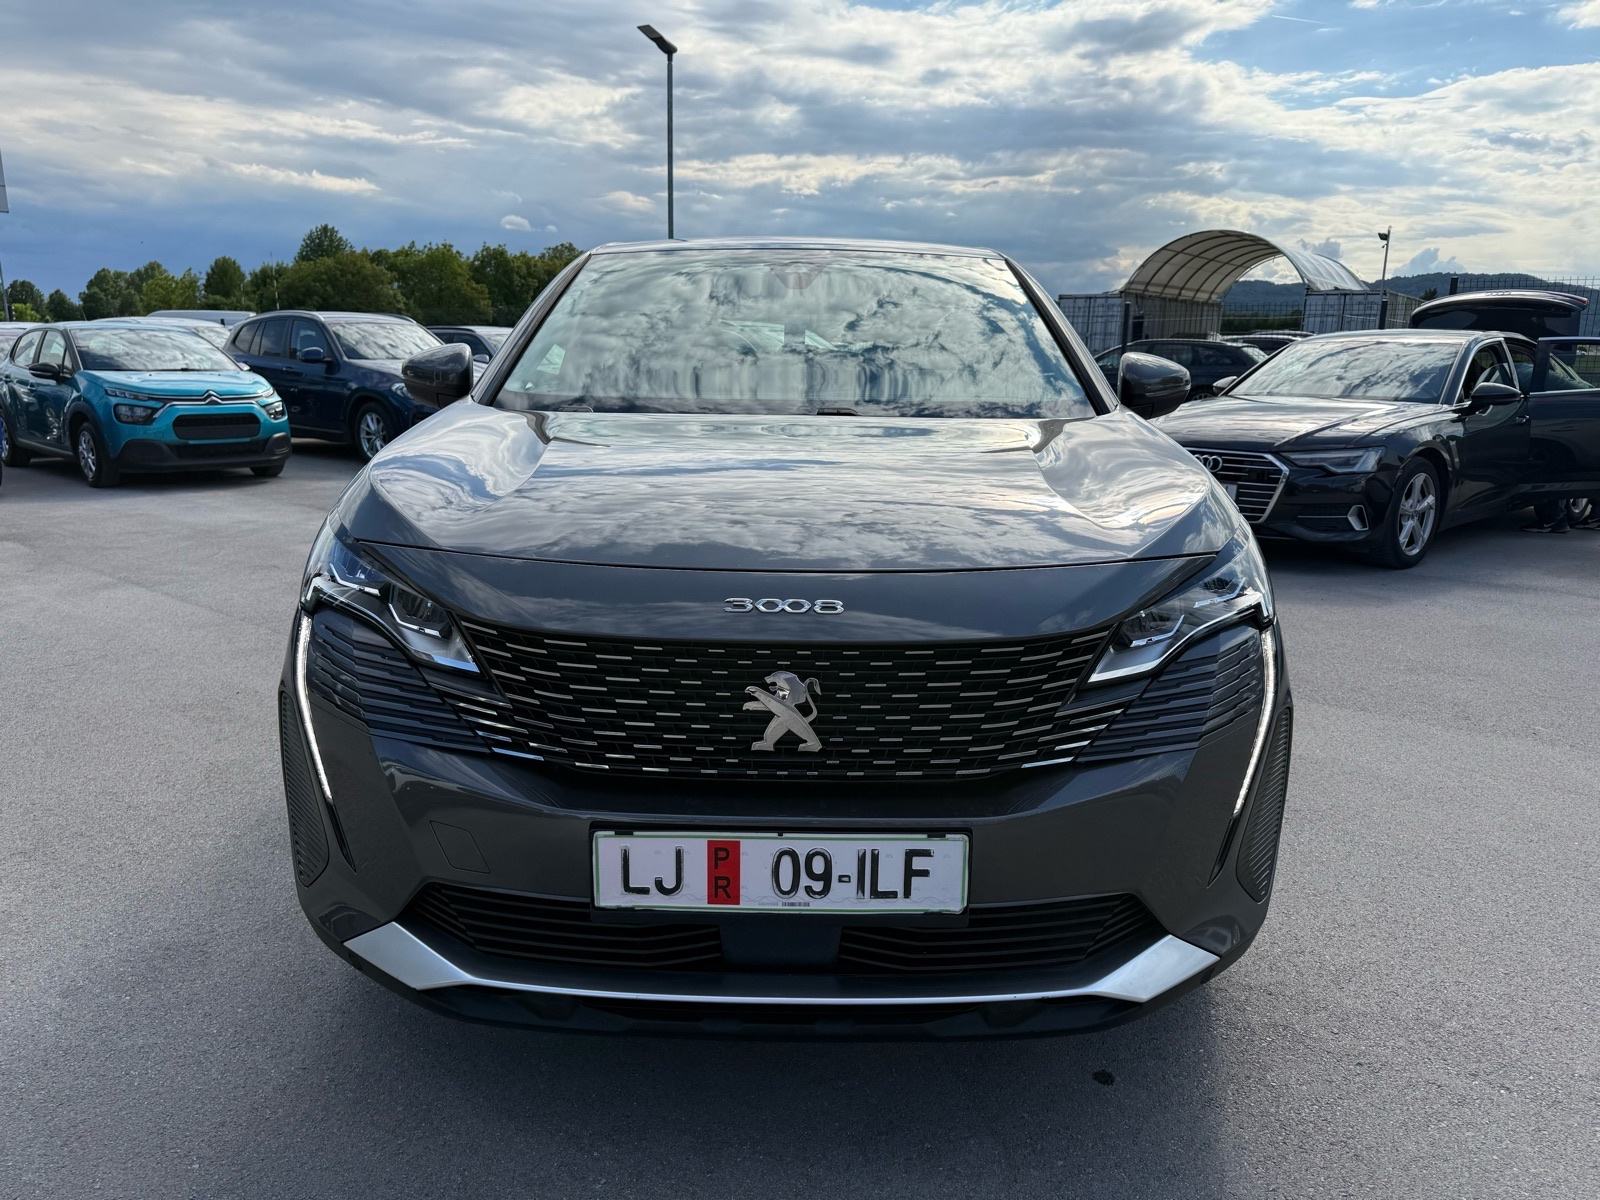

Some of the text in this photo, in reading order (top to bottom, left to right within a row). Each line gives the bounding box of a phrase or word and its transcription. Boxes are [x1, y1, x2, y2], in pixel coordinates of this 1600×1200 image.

[723, 597, 845, 614] 3008
[620, 845, 684, 896] LJ
[772, 847, 934, 900] 09-ILF
